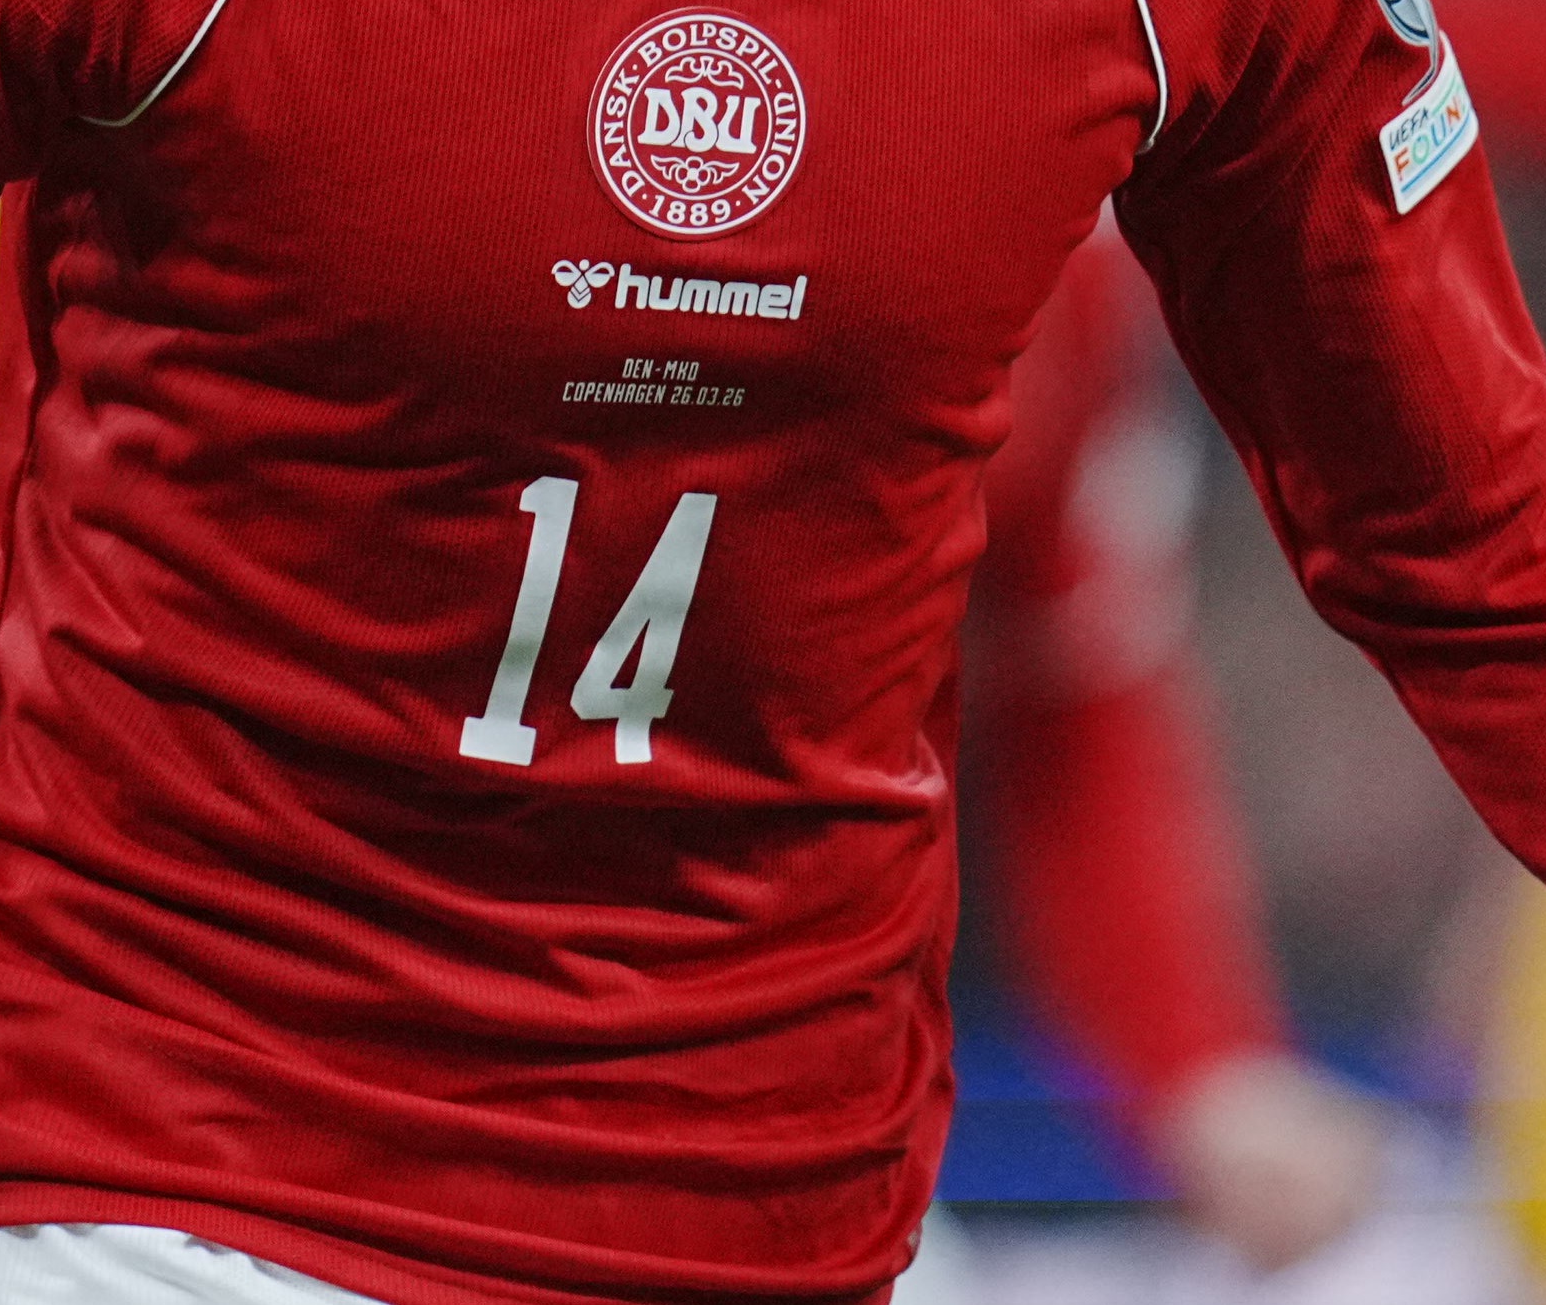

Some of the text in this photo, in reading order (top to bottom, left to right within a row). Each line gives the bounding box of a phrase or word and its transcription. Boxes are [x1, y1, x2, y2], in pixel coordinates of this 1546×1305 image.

[603, 68, 645, 197] DANSK
[637, 86, 762, 154] DBU
[1389, 106, 1429, 152] UEFA
[1394, 87, 1466, 183] FOUN
[649, 195, 731, 227] 1889
[614, 263, 808, 321] hummel
[562, 381, 746, 407] COPENHAGEN 26.03.26
[459, 475, 718, 767] 14
